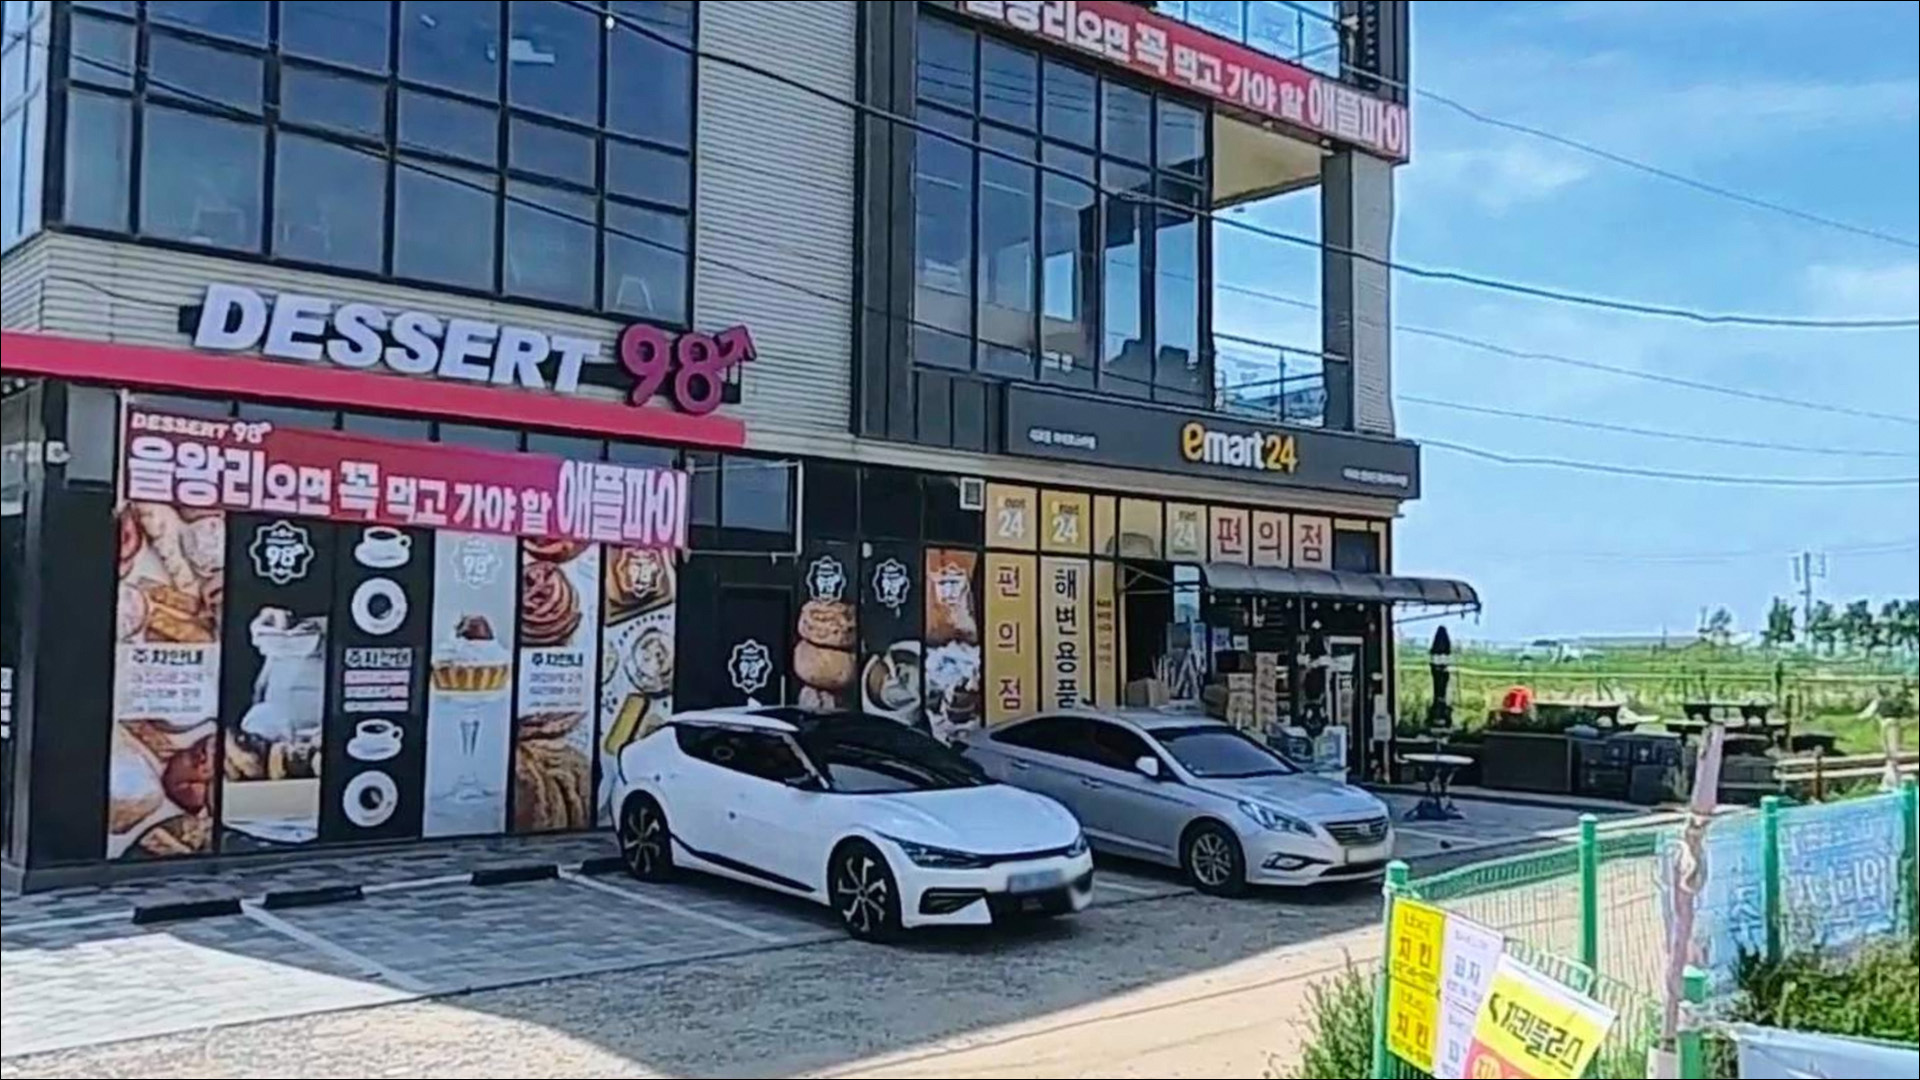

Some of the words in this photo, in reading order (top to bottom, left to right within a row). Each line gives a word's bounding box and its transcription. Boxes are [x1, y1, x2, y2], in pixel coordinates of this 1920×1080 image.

[1135, 22, 1168, 76] 꼭
[1173, 44, 1224, 94] 먹고
[1227, 64, 1276, 113] 가야
[1308, 78, 1407, 156] 애플파이
[194, 283, 599, 393] DESSERT
[621, 323, 722, 416] 98
[131, 412, 229, 439] DESSERT
[232, 421, 263, 443] 98
[1183, 422, 1298, 473] emart24
[128, 436, 332, 516] 을왕리오면
[338, 460, 379, 520] 꼭
[386, 475, 447, 525] 먹고
[453, 484, 517, 532] 가야
[521, 488, 552, 535] 할
[556, 459, 687, 547] 애플파이
[998, 508, 1025, 540] 24
[1052, 513, 1079, 544] 24
[1217, 516, 1323, 562] 편의점
[997, 566, 1021, 711] 편의점
[1055, 568, 1078, 709] 해변용품
